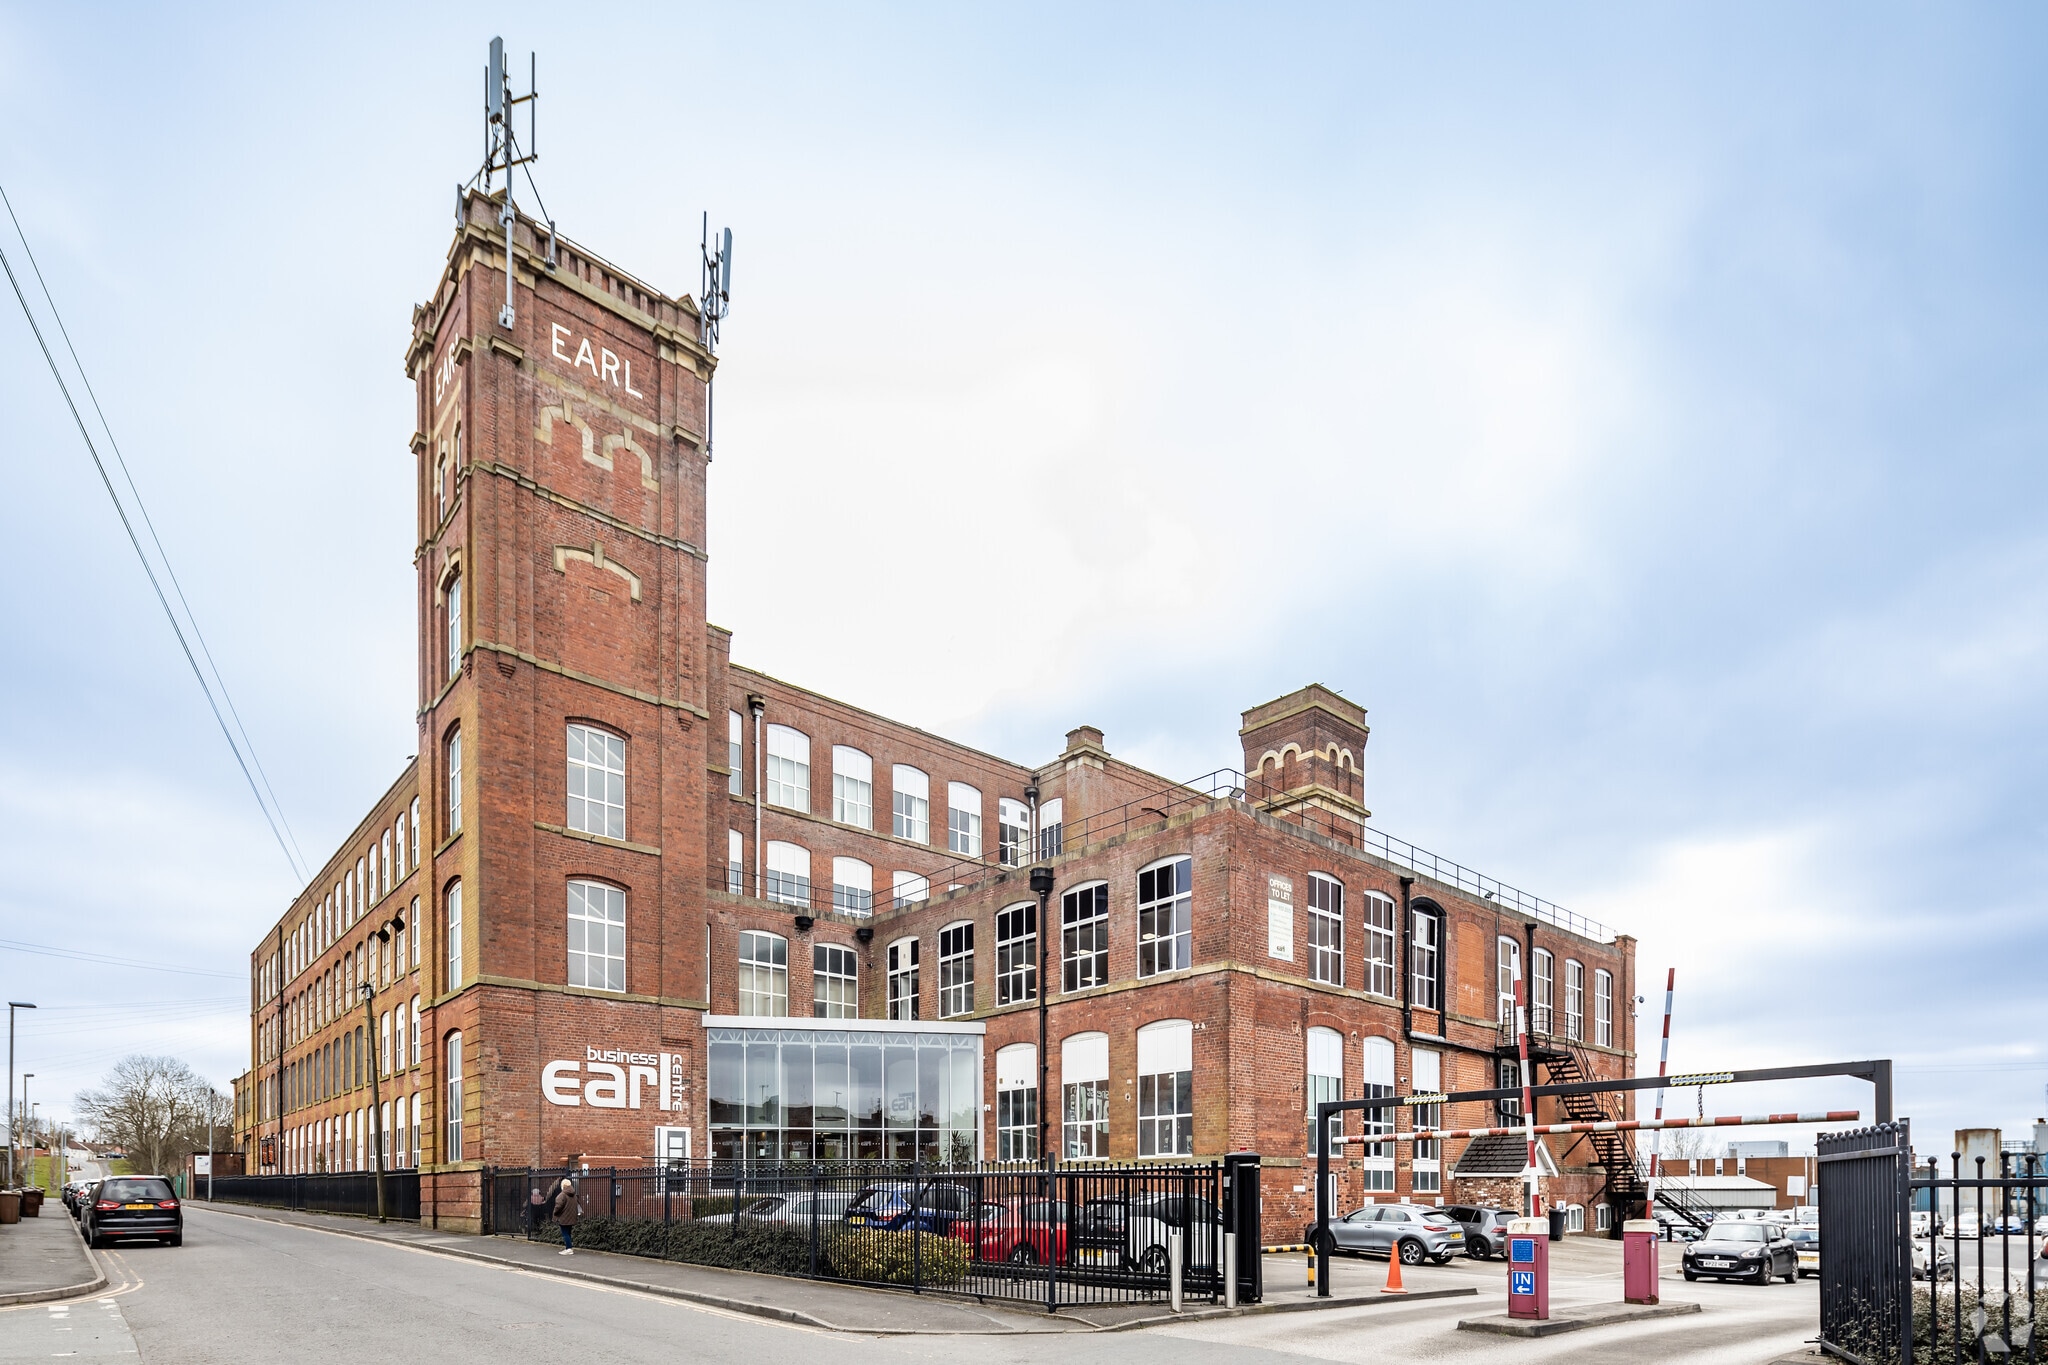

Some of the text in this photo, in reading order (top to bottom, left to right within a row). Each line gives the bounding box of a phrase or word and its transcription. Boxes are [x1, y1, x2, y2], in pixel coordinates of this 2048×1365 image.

[551, 322, 643, 399] EARL
[1269, 878, 1292, 893] OFFICES
[1271, 888, 1291, 901] TO LET
[587, 1045, 658, 1066] business
[541, 1053, 672, 1111] earl
[671, 1053, 686, 1112] centre
[1515, 1273, 1531, 1285] IN
